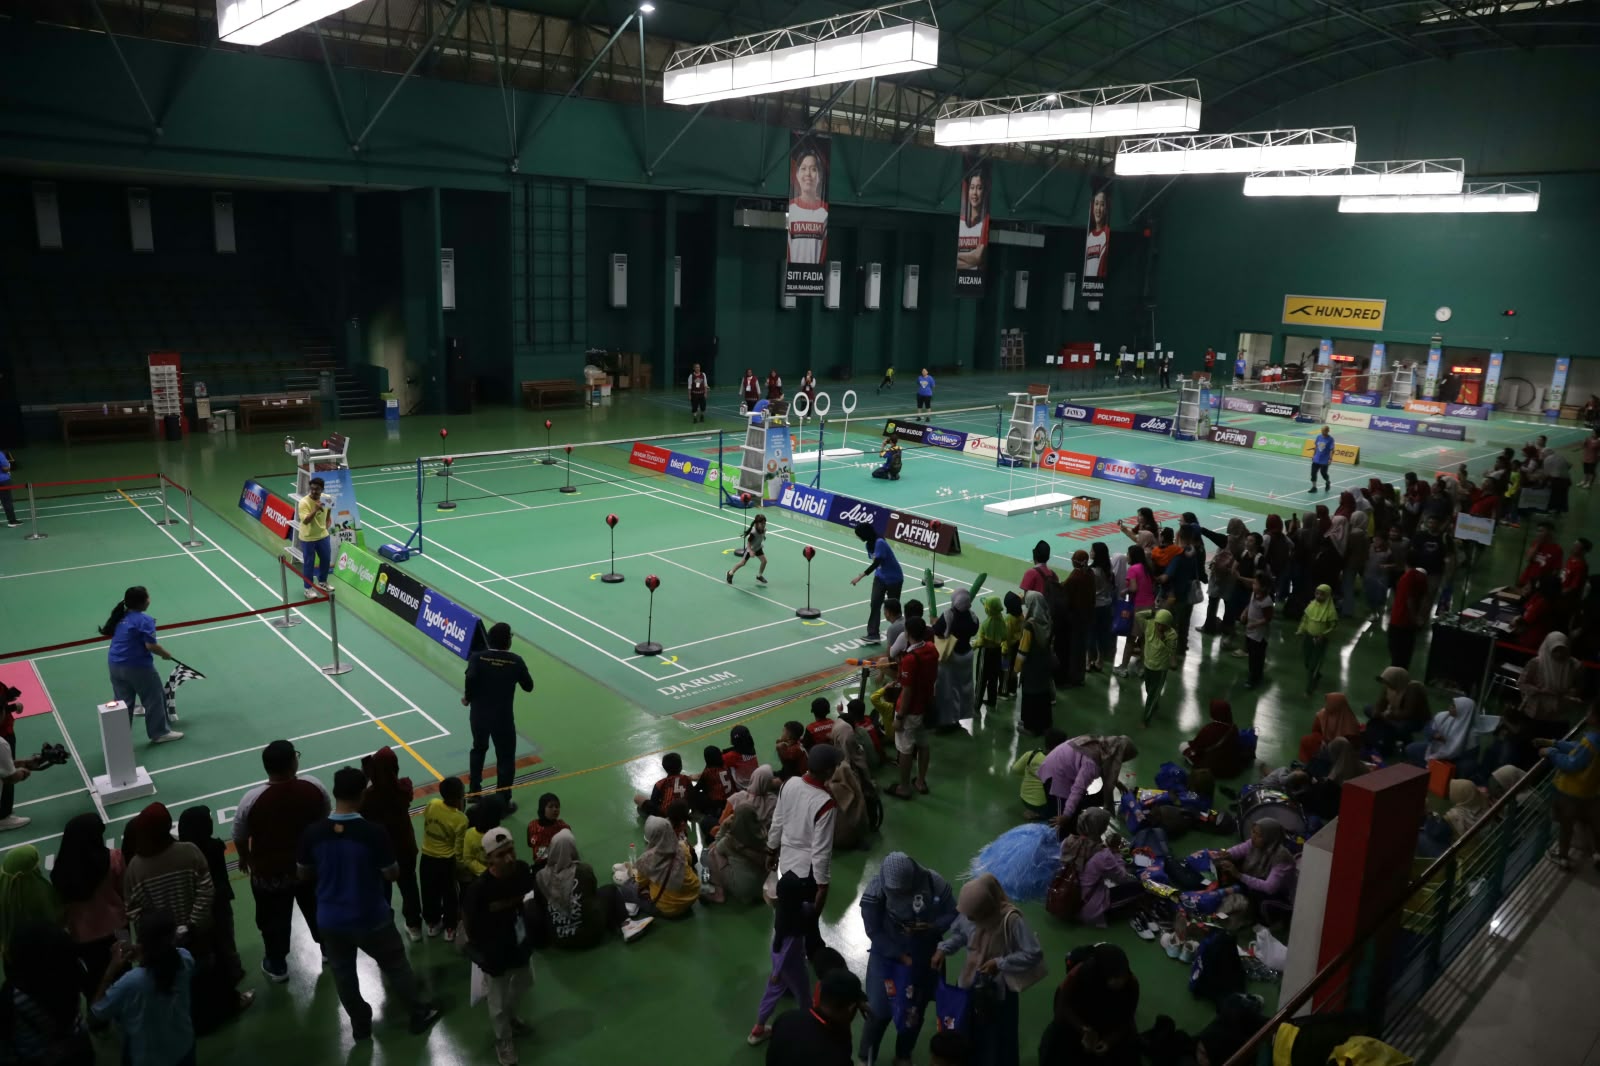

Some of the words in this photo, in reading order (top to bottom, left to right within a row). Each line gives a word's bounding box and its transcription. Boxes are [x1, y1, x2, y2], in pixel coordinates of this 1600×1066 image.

[787, 271, 801, 280] SITI
[803, 272, 824, 281] FADIA
[958, 276, 982, 285] RUZANA
[1315, 306, 1381, 320] HUNDRED
[1097, 413, 1131, 424] POLYTRON
[1141, 417, 1167, 429] Aice
[1215, 431, 1247, 445] CAFFINO
[1155, 473, 1204, 490] hydroplus
[793, 491, 827, 517] blibli
[1072, 503, 1088, 513] Milk
[840, 503, 874, 524] Aice
[1073, 510, 1086, 520] Life
[894, 522, 940, 550] CAFFINO
[386, 583, 399, 598] PBSI
[399, 588, 419, 610] KUDUS
[423, 604, 467, 643] hydroplus
[674, 777, 686, 799] 4
[719, 770, 732, 794] 5
